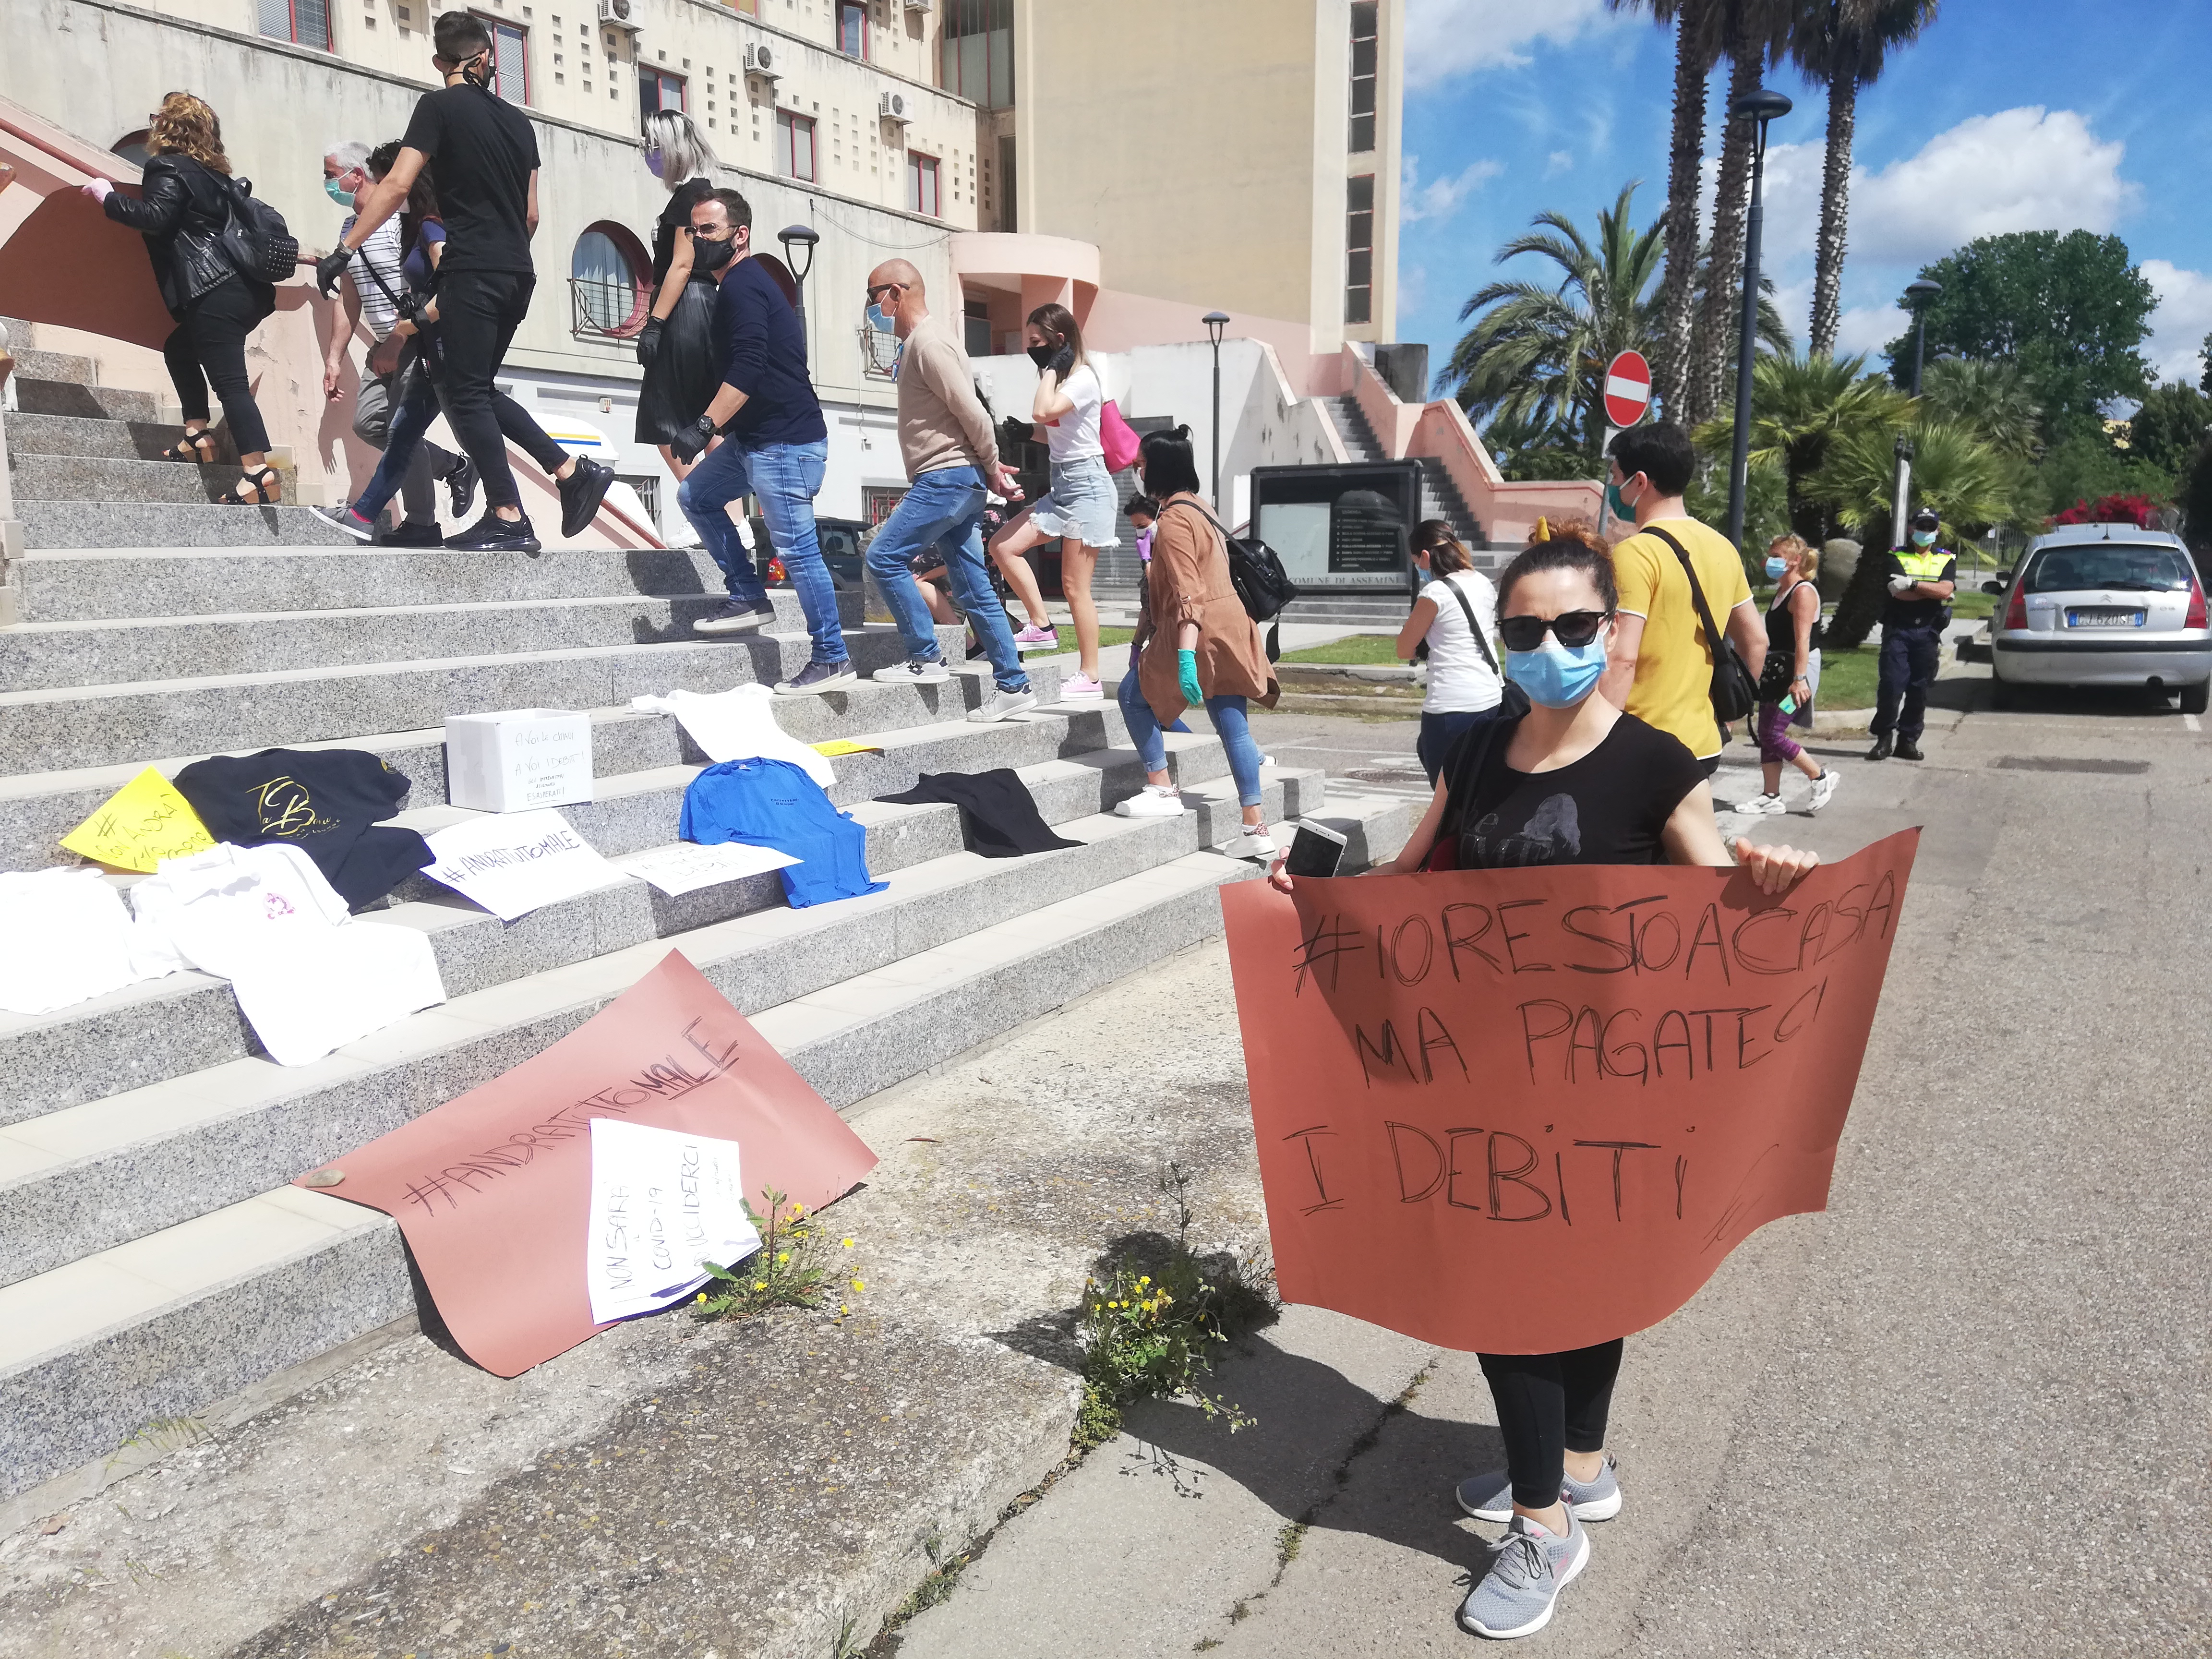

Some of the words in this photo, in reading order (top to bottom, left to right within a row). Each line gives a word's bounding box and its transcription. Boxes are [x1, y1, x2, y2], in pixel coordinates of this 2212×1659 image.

[1289, 577, 1331, 585] COMUNE
[1351, 576, 1399, 584] ASSEMINI
[515, 733, 523, 746] A
[515, 763, 522, 776] A
[525, 756, 540, 771] VOI
[94, 813, 118, 838] #
[1293, 869, 1896, 998] #IORESTOACASA
[1356, 1007, 1471, 1089] MA
[678, 1143, 709, 1247] UCCIDERCI
[1282, 1125, 1344, 1216] I
[649, 1187, 672, 1270] COVID-19
[605, 1256, 636, 1290] NON
